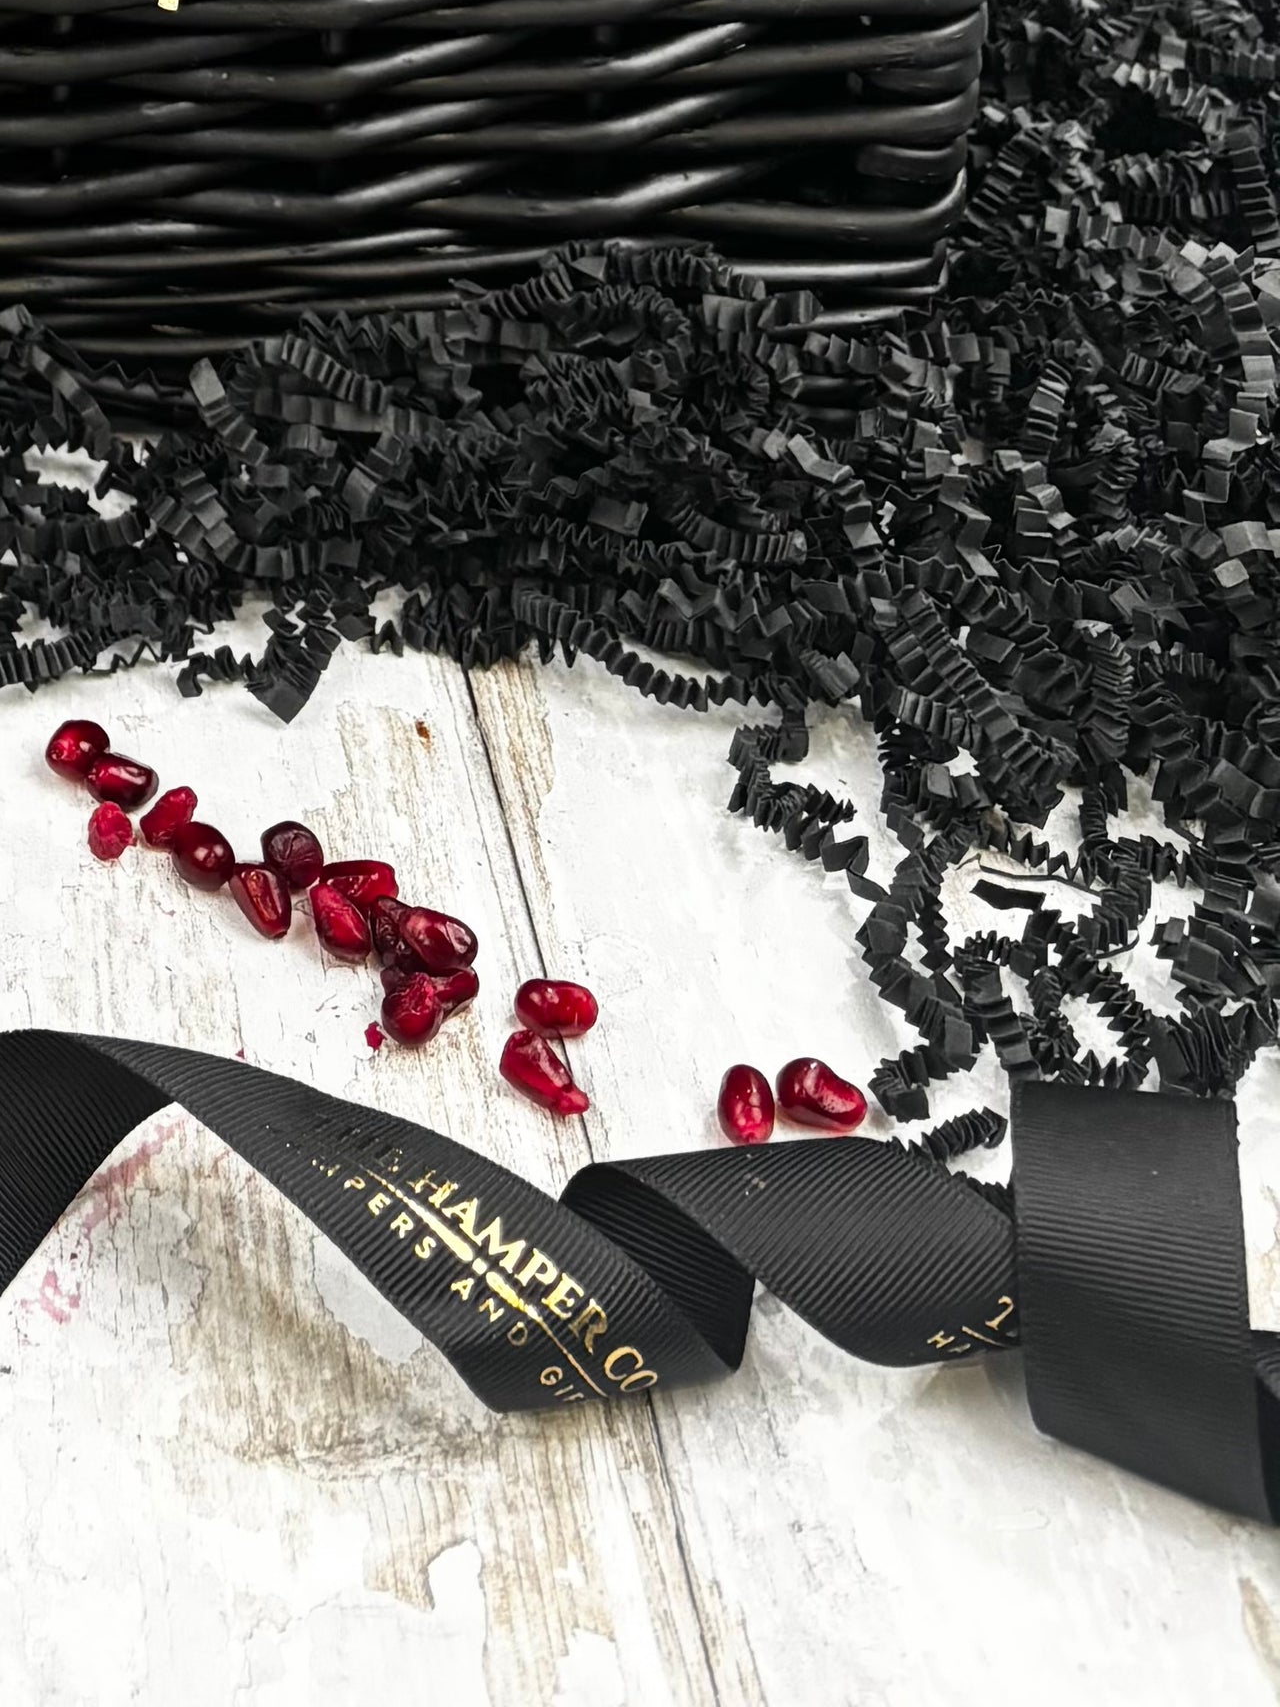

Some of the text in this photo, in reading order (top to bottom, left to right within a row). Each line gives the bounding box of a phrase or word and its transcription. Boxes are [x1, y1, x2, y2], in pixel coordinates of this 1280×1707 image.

[406, 1169, 658, 1393] HAMPER CO
[450, 1275, 529, 1347] AND
